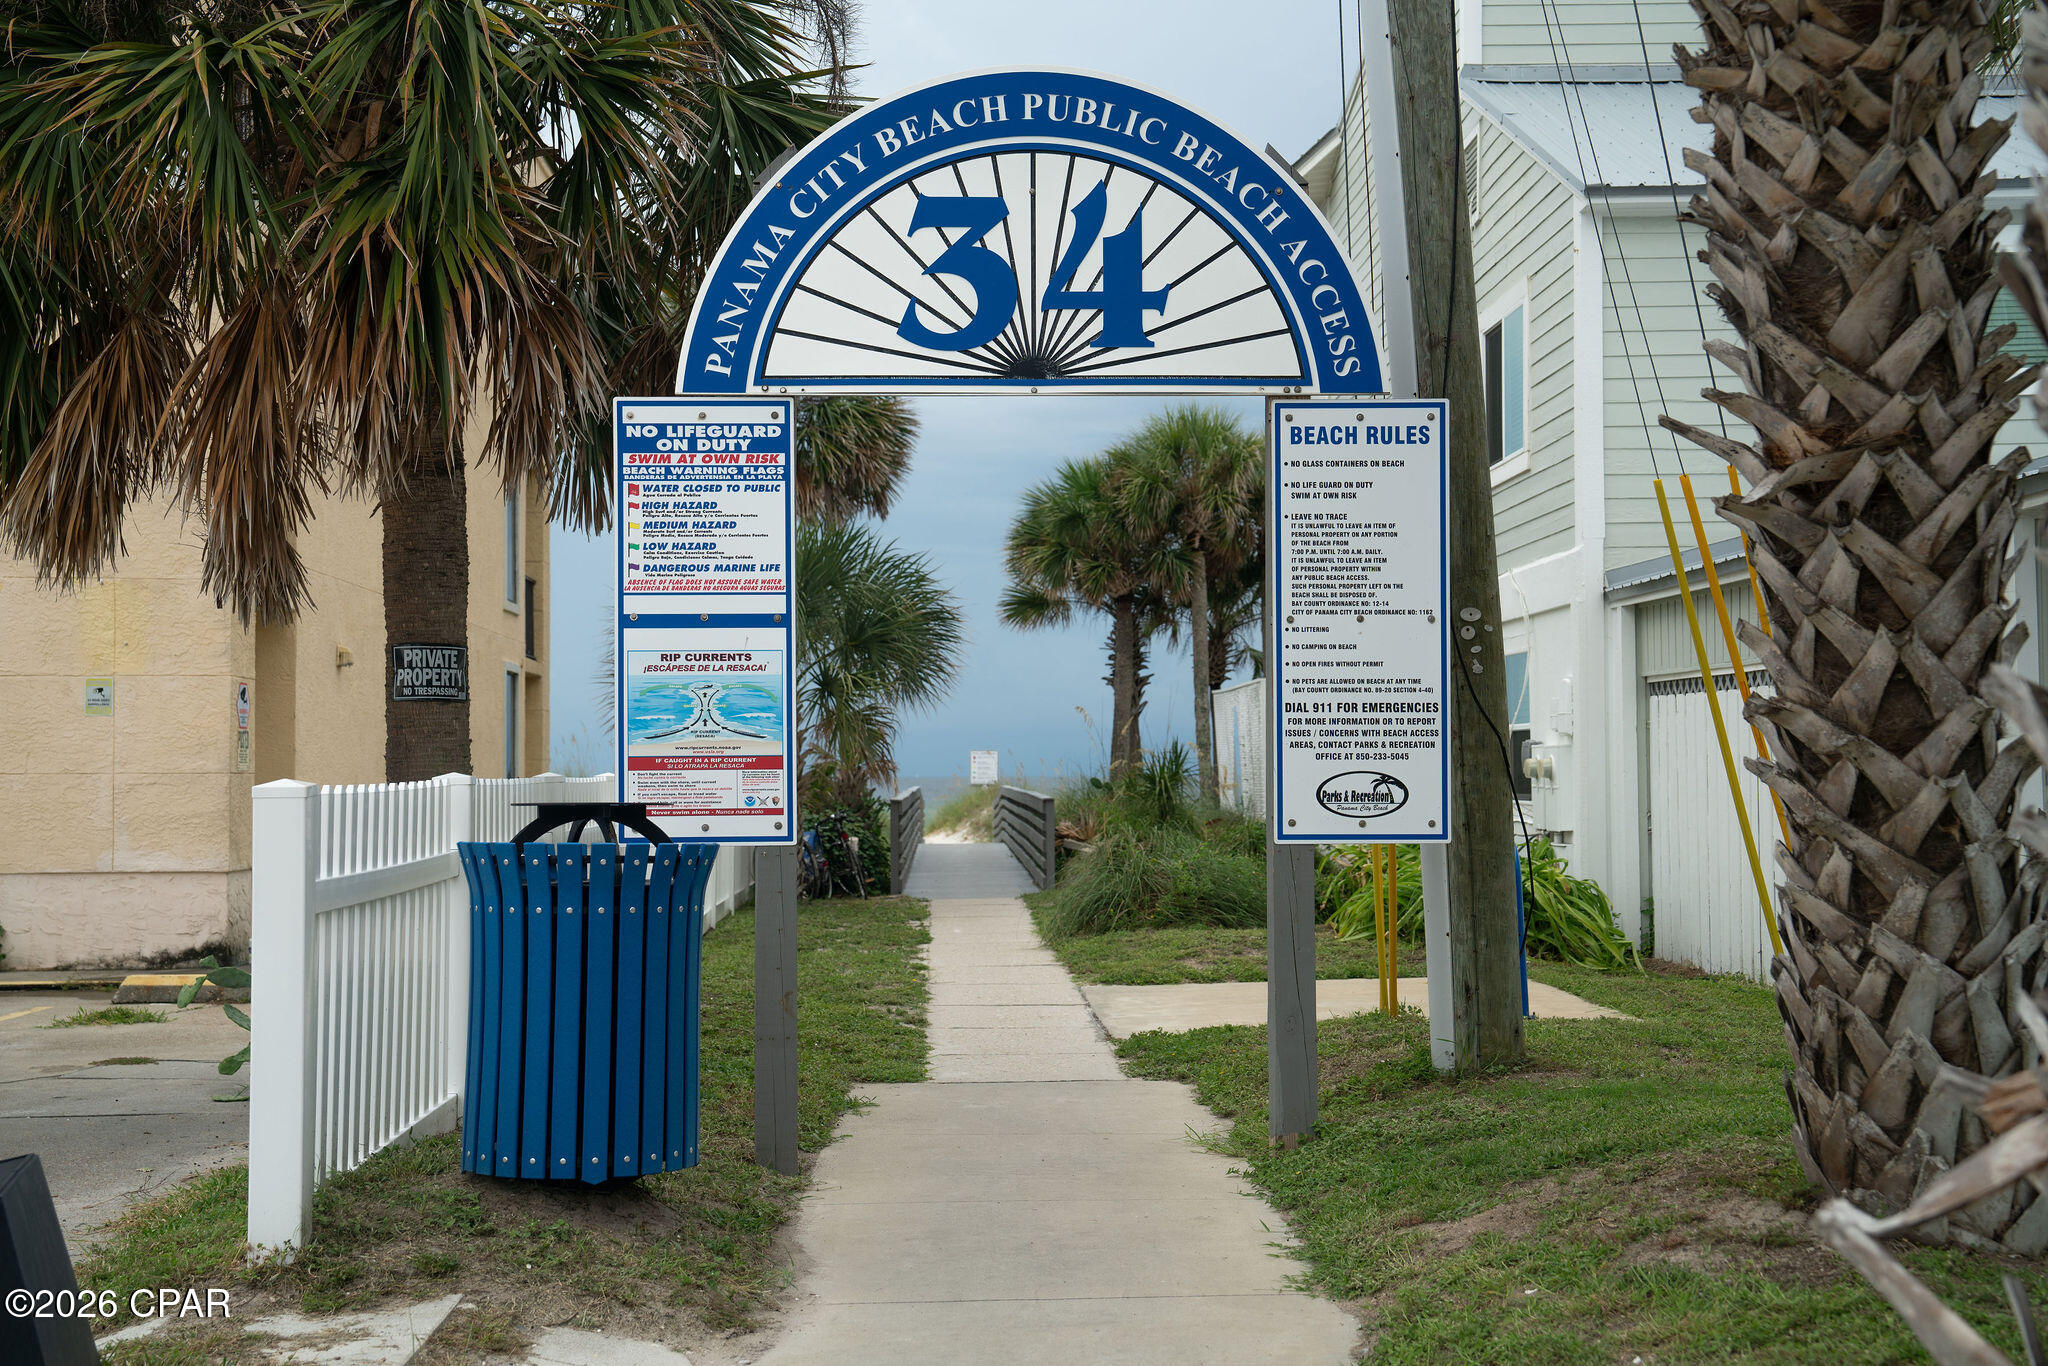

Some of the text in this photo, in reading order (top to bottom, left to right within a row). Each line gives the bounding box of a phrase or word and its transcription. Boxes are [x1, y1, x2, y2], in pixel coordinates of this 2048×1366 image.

[704, 93, 1361, 378] PANAMA CITY BEACH PUBLIC BEACH ACCESS
[896, 179, 1170, 351] 34
[625, 425, 782, 438] NO LIFEGUARD
[1290, 426, 1430, 444] BEACH RULES
[656, 439, 751, 451] ON DUTY
[629, 454, 779, 464] SWIM AT OWN RISK
[623, 466, 784, 474] BEACH WARNING FLAGS
[643, 484, 780, 492] WATER CLOSED TO PUBLIC
[642, 502, 717, 510] HIGH HAZARD
[643, 521, 736, 529] MEDIUM HAZARD
[643, 542, 716, 550] LOW HAZARD
[643, 564, 780, 572] DANGEROUS MARINE LIFE
[404, 649, 458, 668] PRIVATE
[660, 653, 752, 662] RIP CURRENTS
[644, 664, 695, 673] ¡ESCÁPESE
[397, 668, 462, 686] PROPERTY
[403, 687, 458, 696] NO TRESPASSING
[1285, 702, 1439, 713] DIAL 911 FOR EMERGENCIES
[1322, 790, 1389, 802] Parks & Recreation
